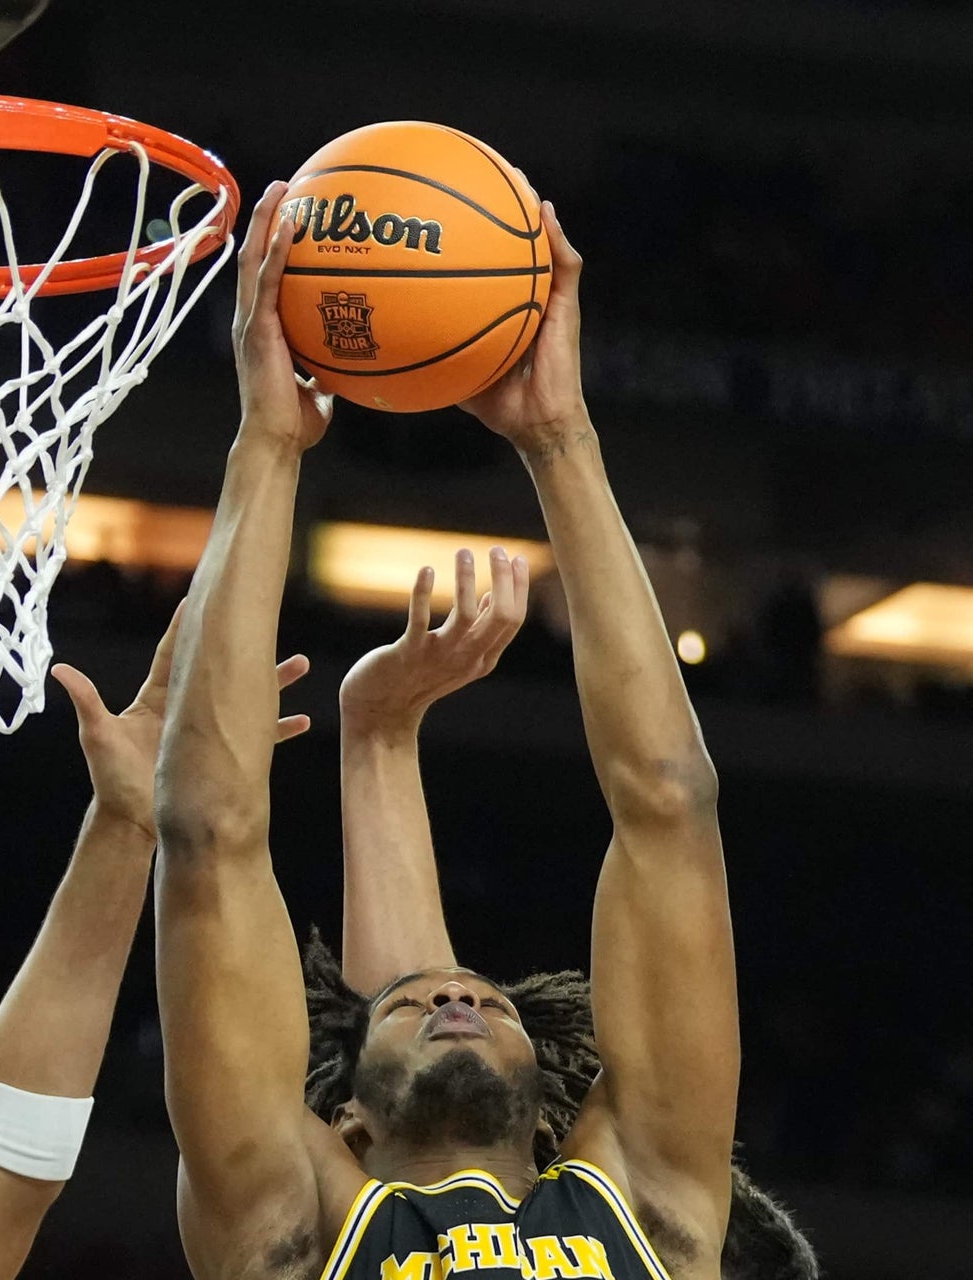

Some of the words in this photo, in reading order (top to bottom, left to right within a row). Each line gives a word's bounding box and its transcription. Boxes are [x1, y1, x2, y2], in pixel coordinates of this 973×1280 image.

[280, 193, 442, 255] Wilson
[317, 246, 341, 254] EVO
[344, 246, 371, 255] NXT
[324, 306, 364, 322] FINAL
[331, 335, 369, 350] FOUR
